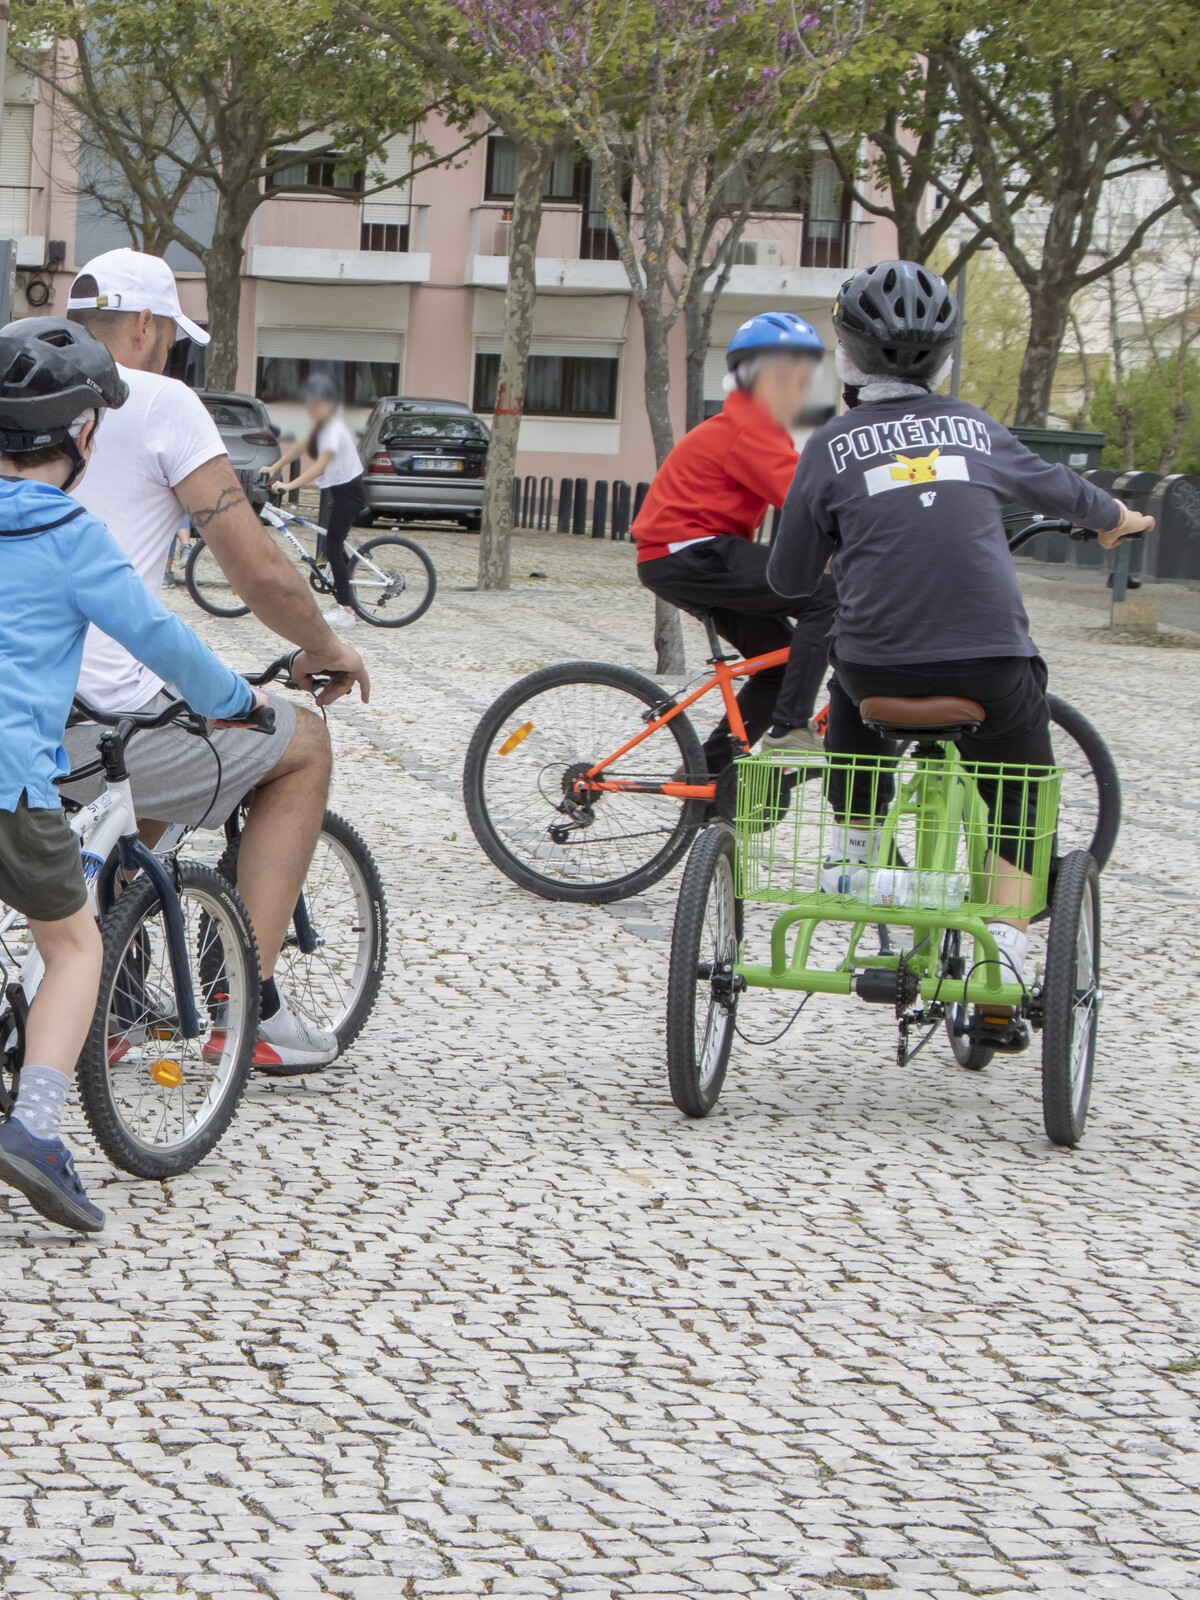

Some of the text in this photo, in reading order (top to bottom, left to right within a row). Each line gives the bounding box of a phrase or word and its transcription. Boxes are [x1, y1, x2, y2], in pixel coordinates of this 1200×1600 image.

[86, 377, 103, 394] BTWIN
[828, 414, 992, 474] POKÉMON
[849, 838, 867, 848] NIKE
[990, 929, 1008, 939] NIKE
